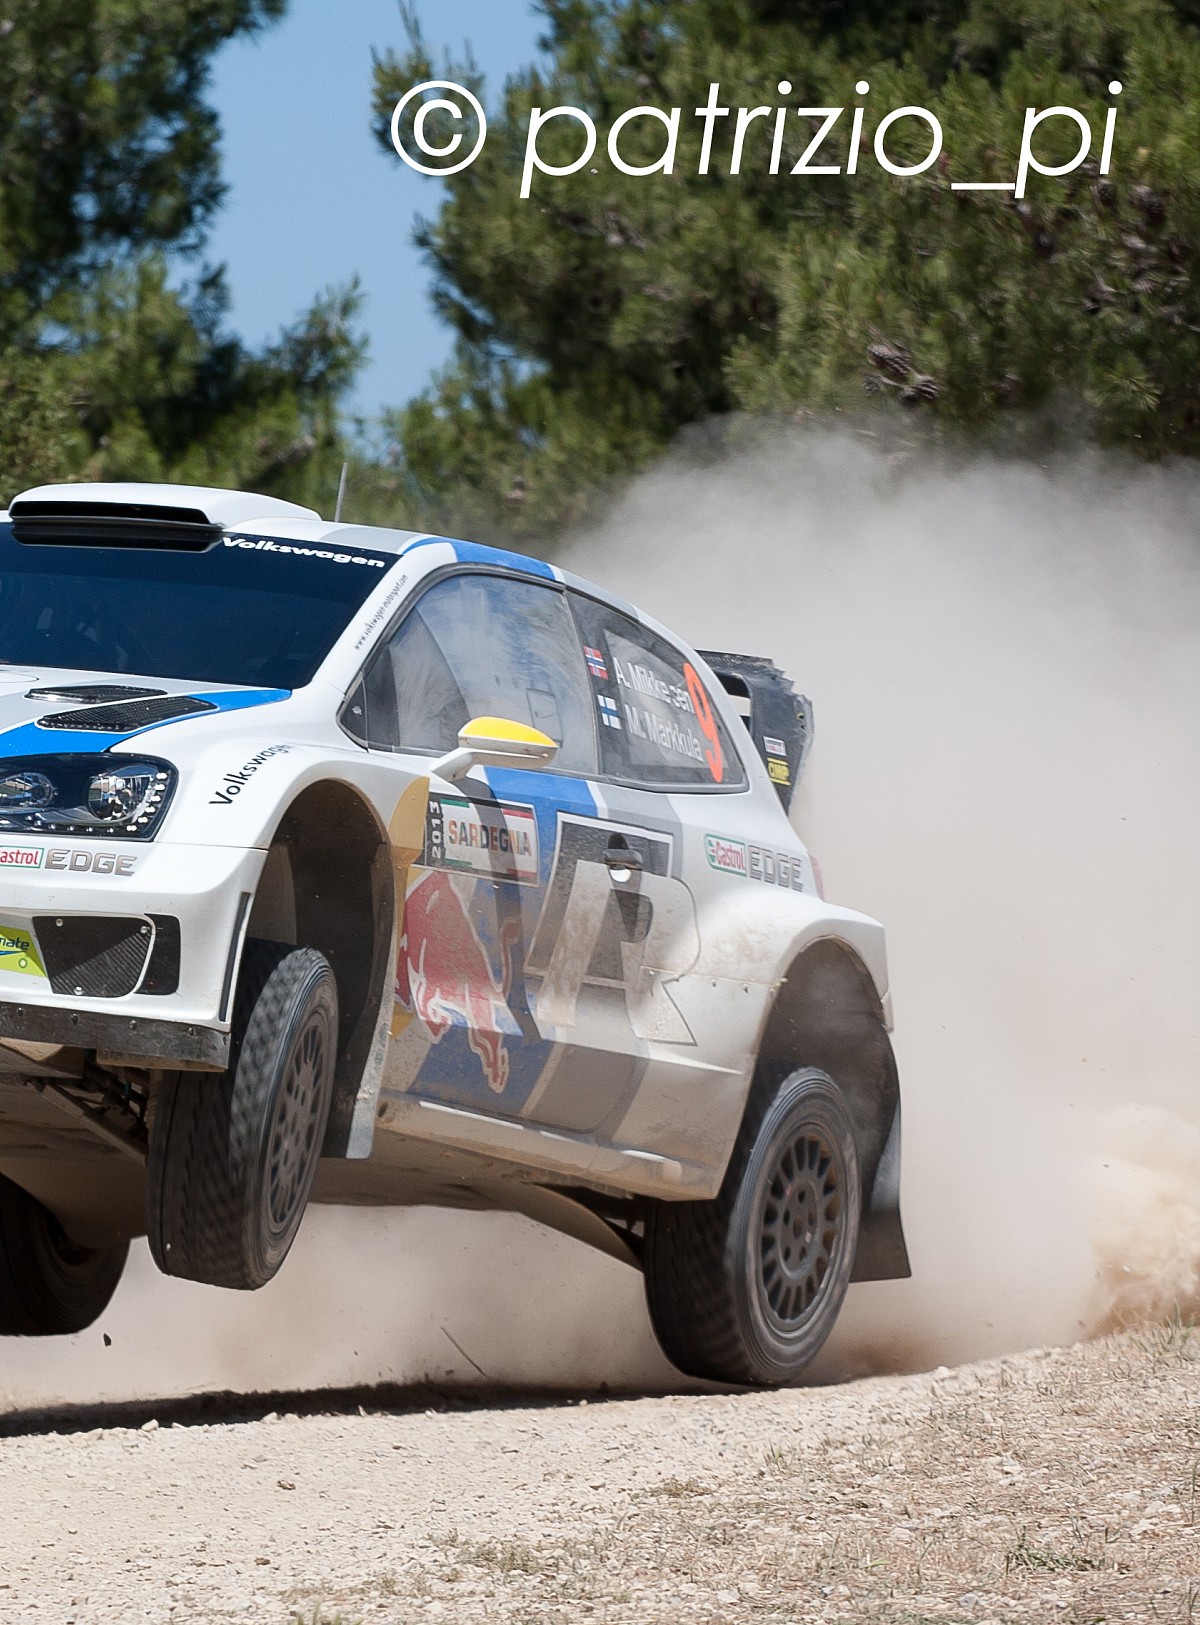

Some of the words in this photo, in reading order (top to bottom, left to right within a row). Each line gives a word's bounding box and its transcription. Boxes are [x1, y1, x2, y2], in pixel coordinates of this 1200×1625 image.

[222, 536, 386, 568] Volkswagen
[613, 657, 631, 688] A.
[625, 704, 646, 738] M.
[644, 711, 704, 763] Markkula
[683, 662, 723, 783] 9
[429, 801, 442, 859] 2013
[448, 819, 532, 857] SARDEGNA
[44, 848, 138, 877] EDGE
[715, 840, 745, 870] Castrol
[748, 845, 803, 892] EDGE
